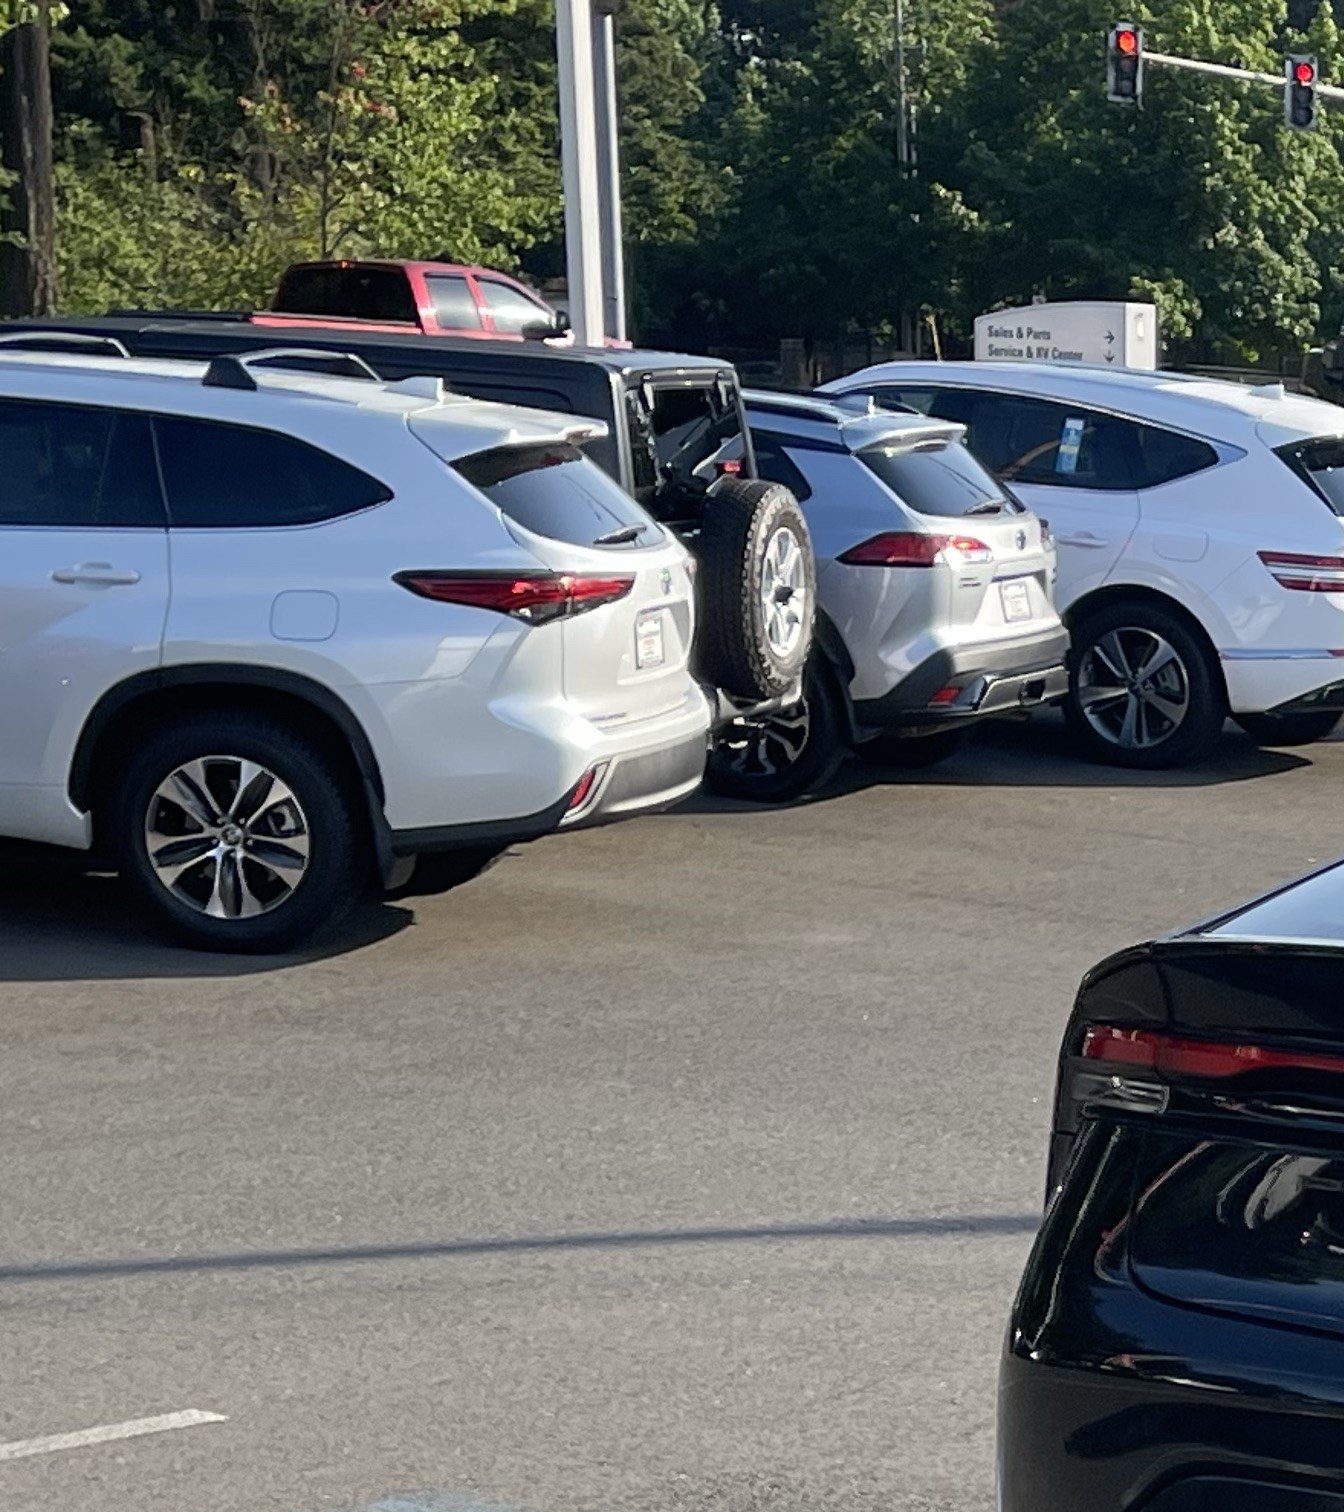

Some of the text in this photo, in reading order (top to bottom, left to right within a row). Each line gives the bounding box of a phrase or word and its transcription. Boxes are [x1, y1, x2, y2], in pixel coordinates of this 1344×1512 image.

[987, 325, 1051, 340] Sales & Parts
[988, 344, 1023, 357] Service
[1026, 346, 1033, 358] &
[1052, 347, 1083, 361] Center
